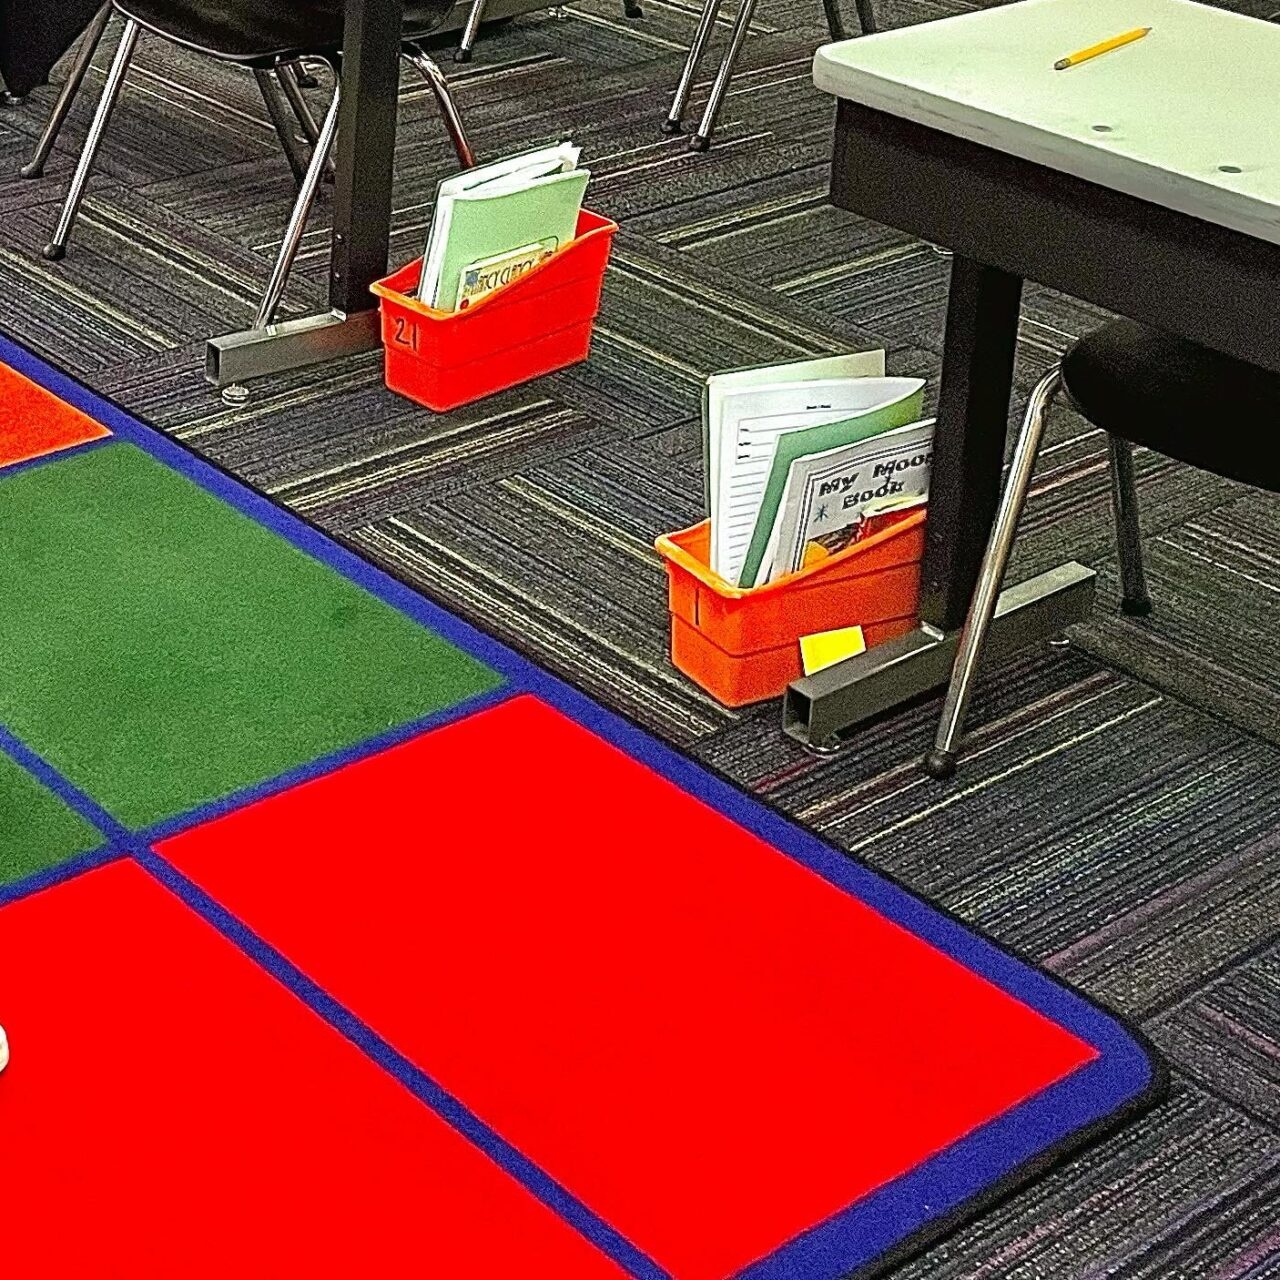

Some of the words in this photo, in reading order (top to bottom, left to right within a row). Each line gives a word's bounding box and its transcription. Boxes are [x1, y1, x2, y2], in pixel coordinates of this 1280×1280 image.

[394, 317, 417, 351] 21
[818, 472, 859, 498] My
[842, 480, 905, 510] Book
